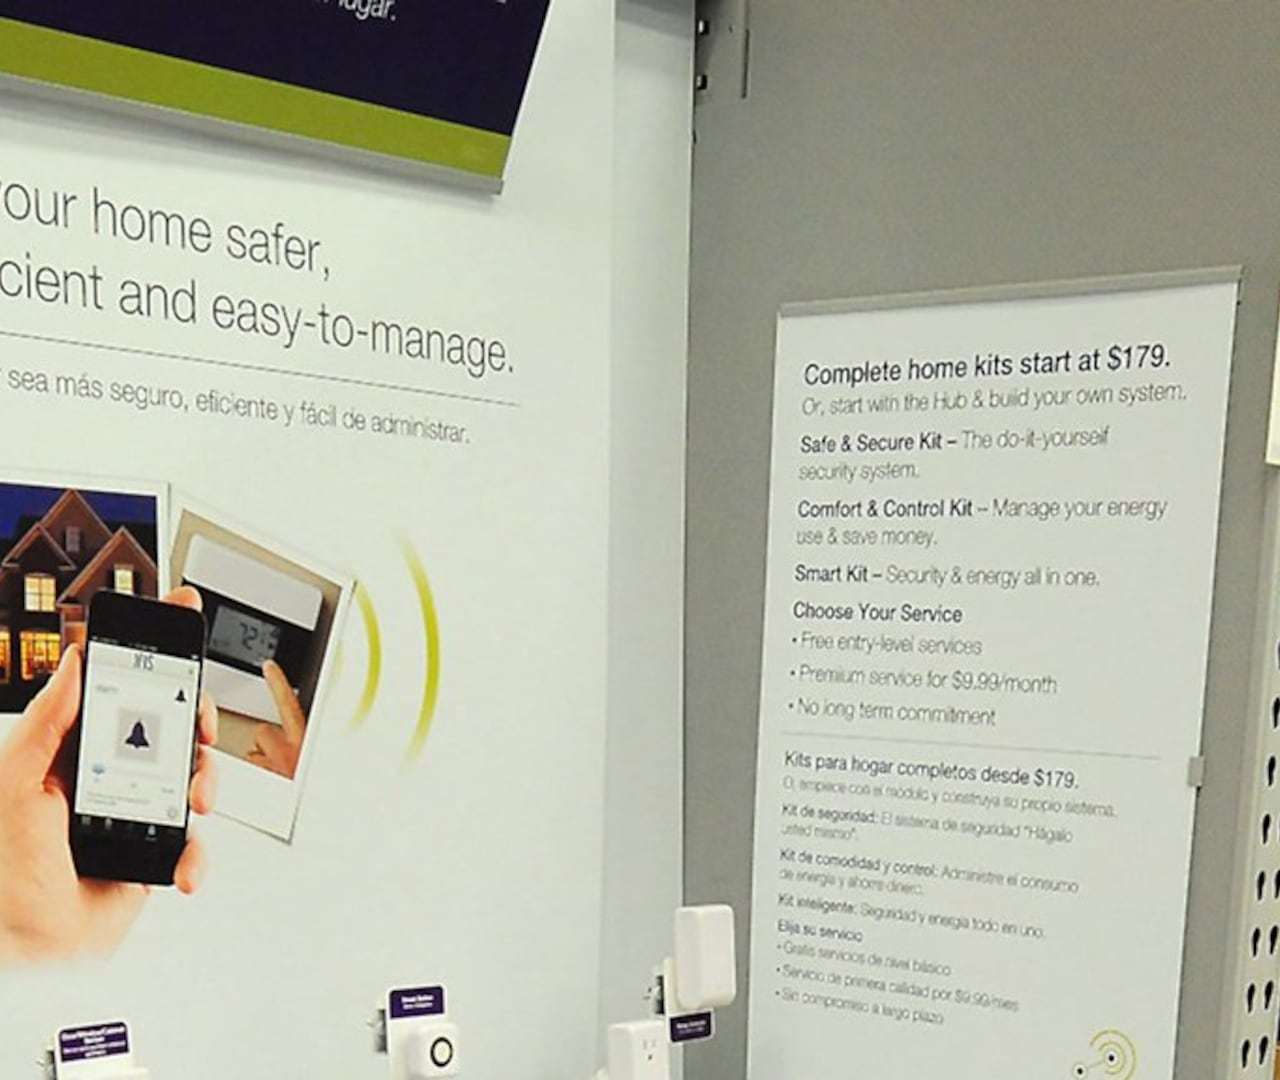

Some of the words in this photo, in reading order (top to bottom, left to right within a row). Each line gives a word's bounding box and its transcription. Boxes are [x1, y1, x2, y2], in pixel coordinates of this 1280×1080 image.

[93, 187, 211, 253] home
[227, 222, 329, 281] safer,
[119, 279, 196, 324] and
[213, 295, 513, 378] easy-to-manage.
[805, 361, 901, 388] Complete
[908, 358, 967, 380] home
[974, 354, 1013, 377] kits
[1020, 351, 1072, 375] start
[1078, 349, 1100, 372] at
[1107, 344, 1170, 371] $179.
[8, 370, 52, 393] sea
[55, 373, 104, 399] más
[108, 382, 188, 412] seguro,
[196, 390, 278, 420] eficiente
[283, 405, 295, 427] y
[300, 401, 336, 427] fácil
[342, 412, 366, 431] de
[371, 413, 469, 443] administrar.
[830, 397, 863, 415] start
[867, 396, 900, 412] with
[904, 393, 929, 411] the
[933, 391, 969, 410] Hub
[971, 389, 984, 409] &
[989, 387, 1030, 408] build
[1033, 390, 1073, 410] your
[1076, 388, 1113, 405] own
[1118, 383, 1187, 406] system.
[801, 435, 837, 453] Safe
[841, 435, 852, 452] &
[857, 434, 915, 452] Secure
[919, 432, 942, 450] Kit
[962, 430, 992, 448] The
[996, 426, 1109, 450] do-it-yourself
[798, 500, 862, 518] Comfort
[867, 499, 880, 518] &
[883, 499, 944, 518] Control
[949, 498, 972, 517] Kit
[993, 498, 1060, 521] Manage
[1065, 502, 1103, 520] your
[1107, 501, 1167, 521] energy
[795, 564, 842, 582] Smart
[846, 565, 868, 583] Kit
[886, 565, 948, 587] Security
[950, 566, 961, 584] &
[966, 570, 1021, 589] energy
[1024, 568, 1041, 585] all
[1046, 568, 1060, 584] in
[1064, 571, 1099, 585] one.
[793, 601, 854, 620] Choose
[858, 603, 896, 621] Your
[900, 604, 962, 623] Service
[801, 630, 834, 649] Free
[837, 634, 914, 654] entry-level
[918, 636, 982, 655] services
[799, 664, 865, 683] Premium
[869, 671, 923, 688] service
[927, 670, 948, 688] for
[952, 670, 1057, 693] $9.99/month
[785, 751, 811, 768] Kits
[815, 757, 847, 772] para
[851, 756, 892, 778] hogar
[897, 763, 976, 783] completos
[981, 766, 1030, 785] desde
[1034, 768, 1078, 789] $179.
